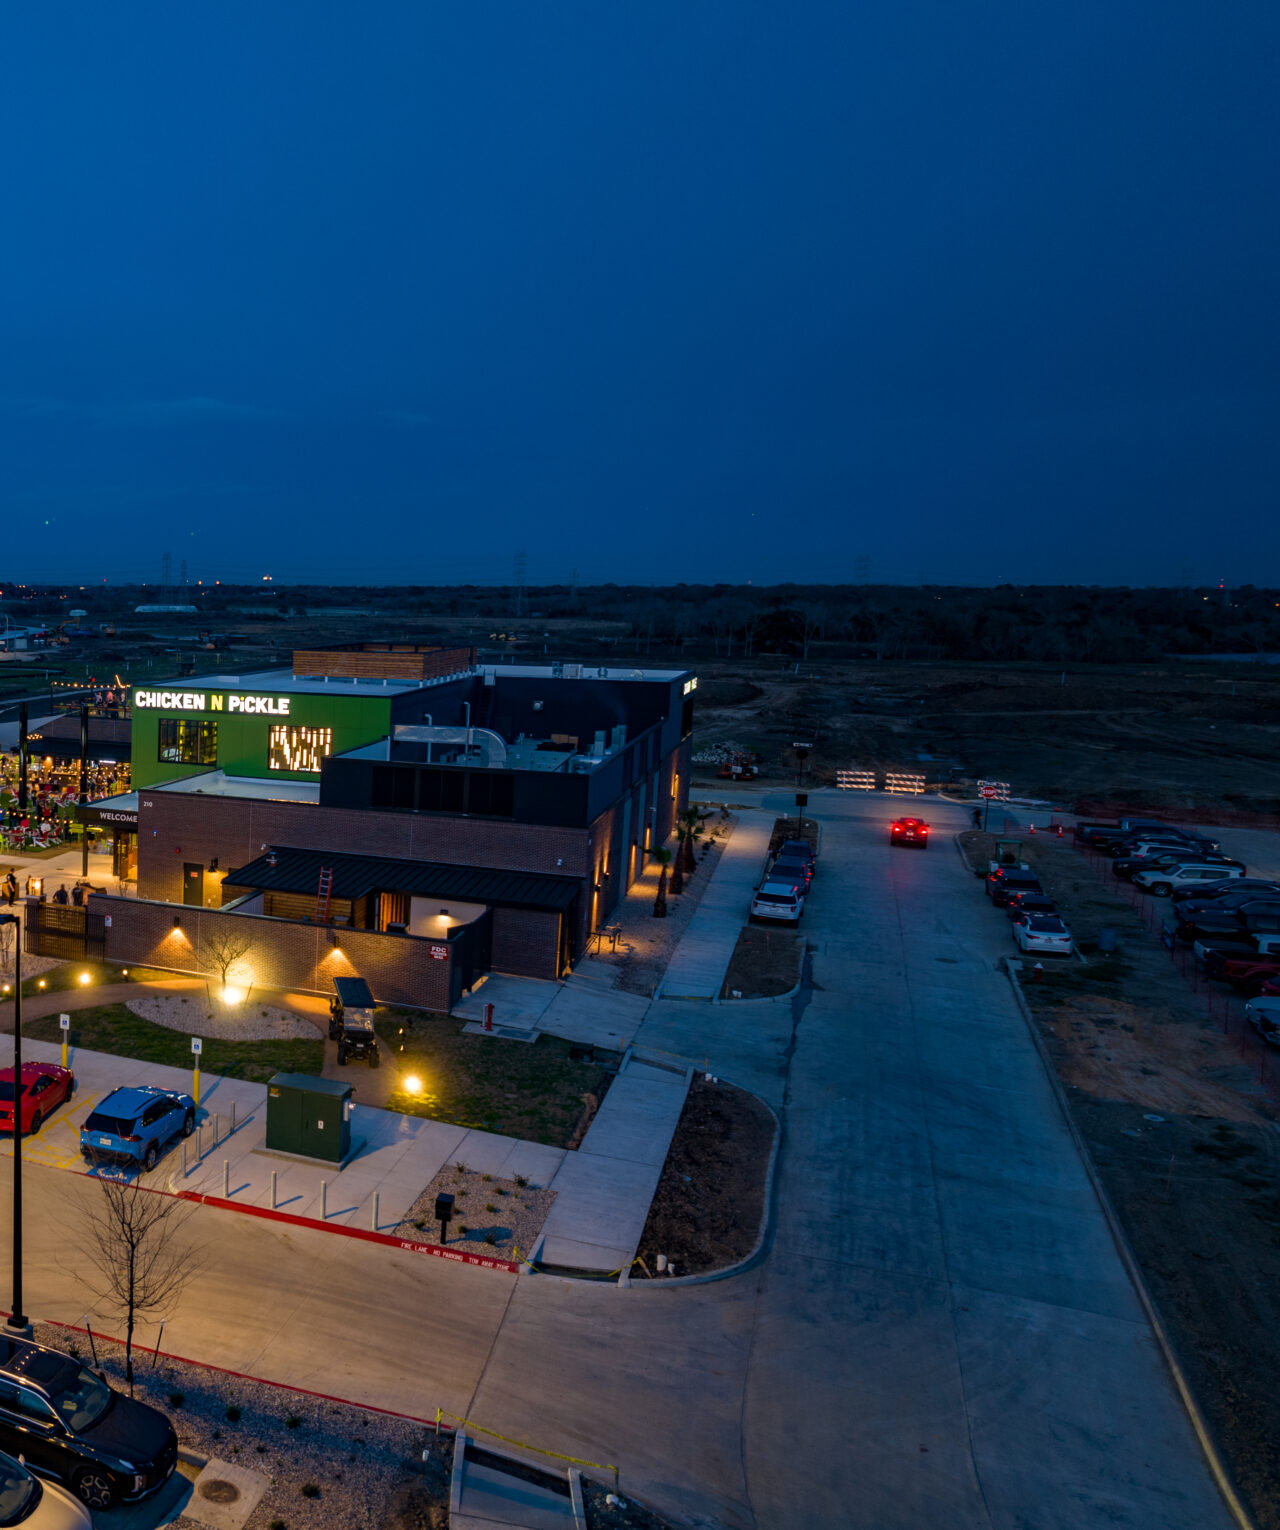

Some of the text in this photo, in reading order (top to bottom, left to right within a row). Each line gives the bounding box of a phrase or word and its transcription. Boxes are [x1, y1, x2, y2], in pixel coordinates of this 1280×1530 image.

[135, 690, 205, 710] CHICKEN
[210, 694, 223, 711] N
[99, 811, 138, 823] WELCOME
[400, 1242, 412, 1250] FIRE
[414, 1245, 428, 1254] LANE
[442, 1251, 463, 1262] PARKING
[469, 1257, 480, 1265] TOW
